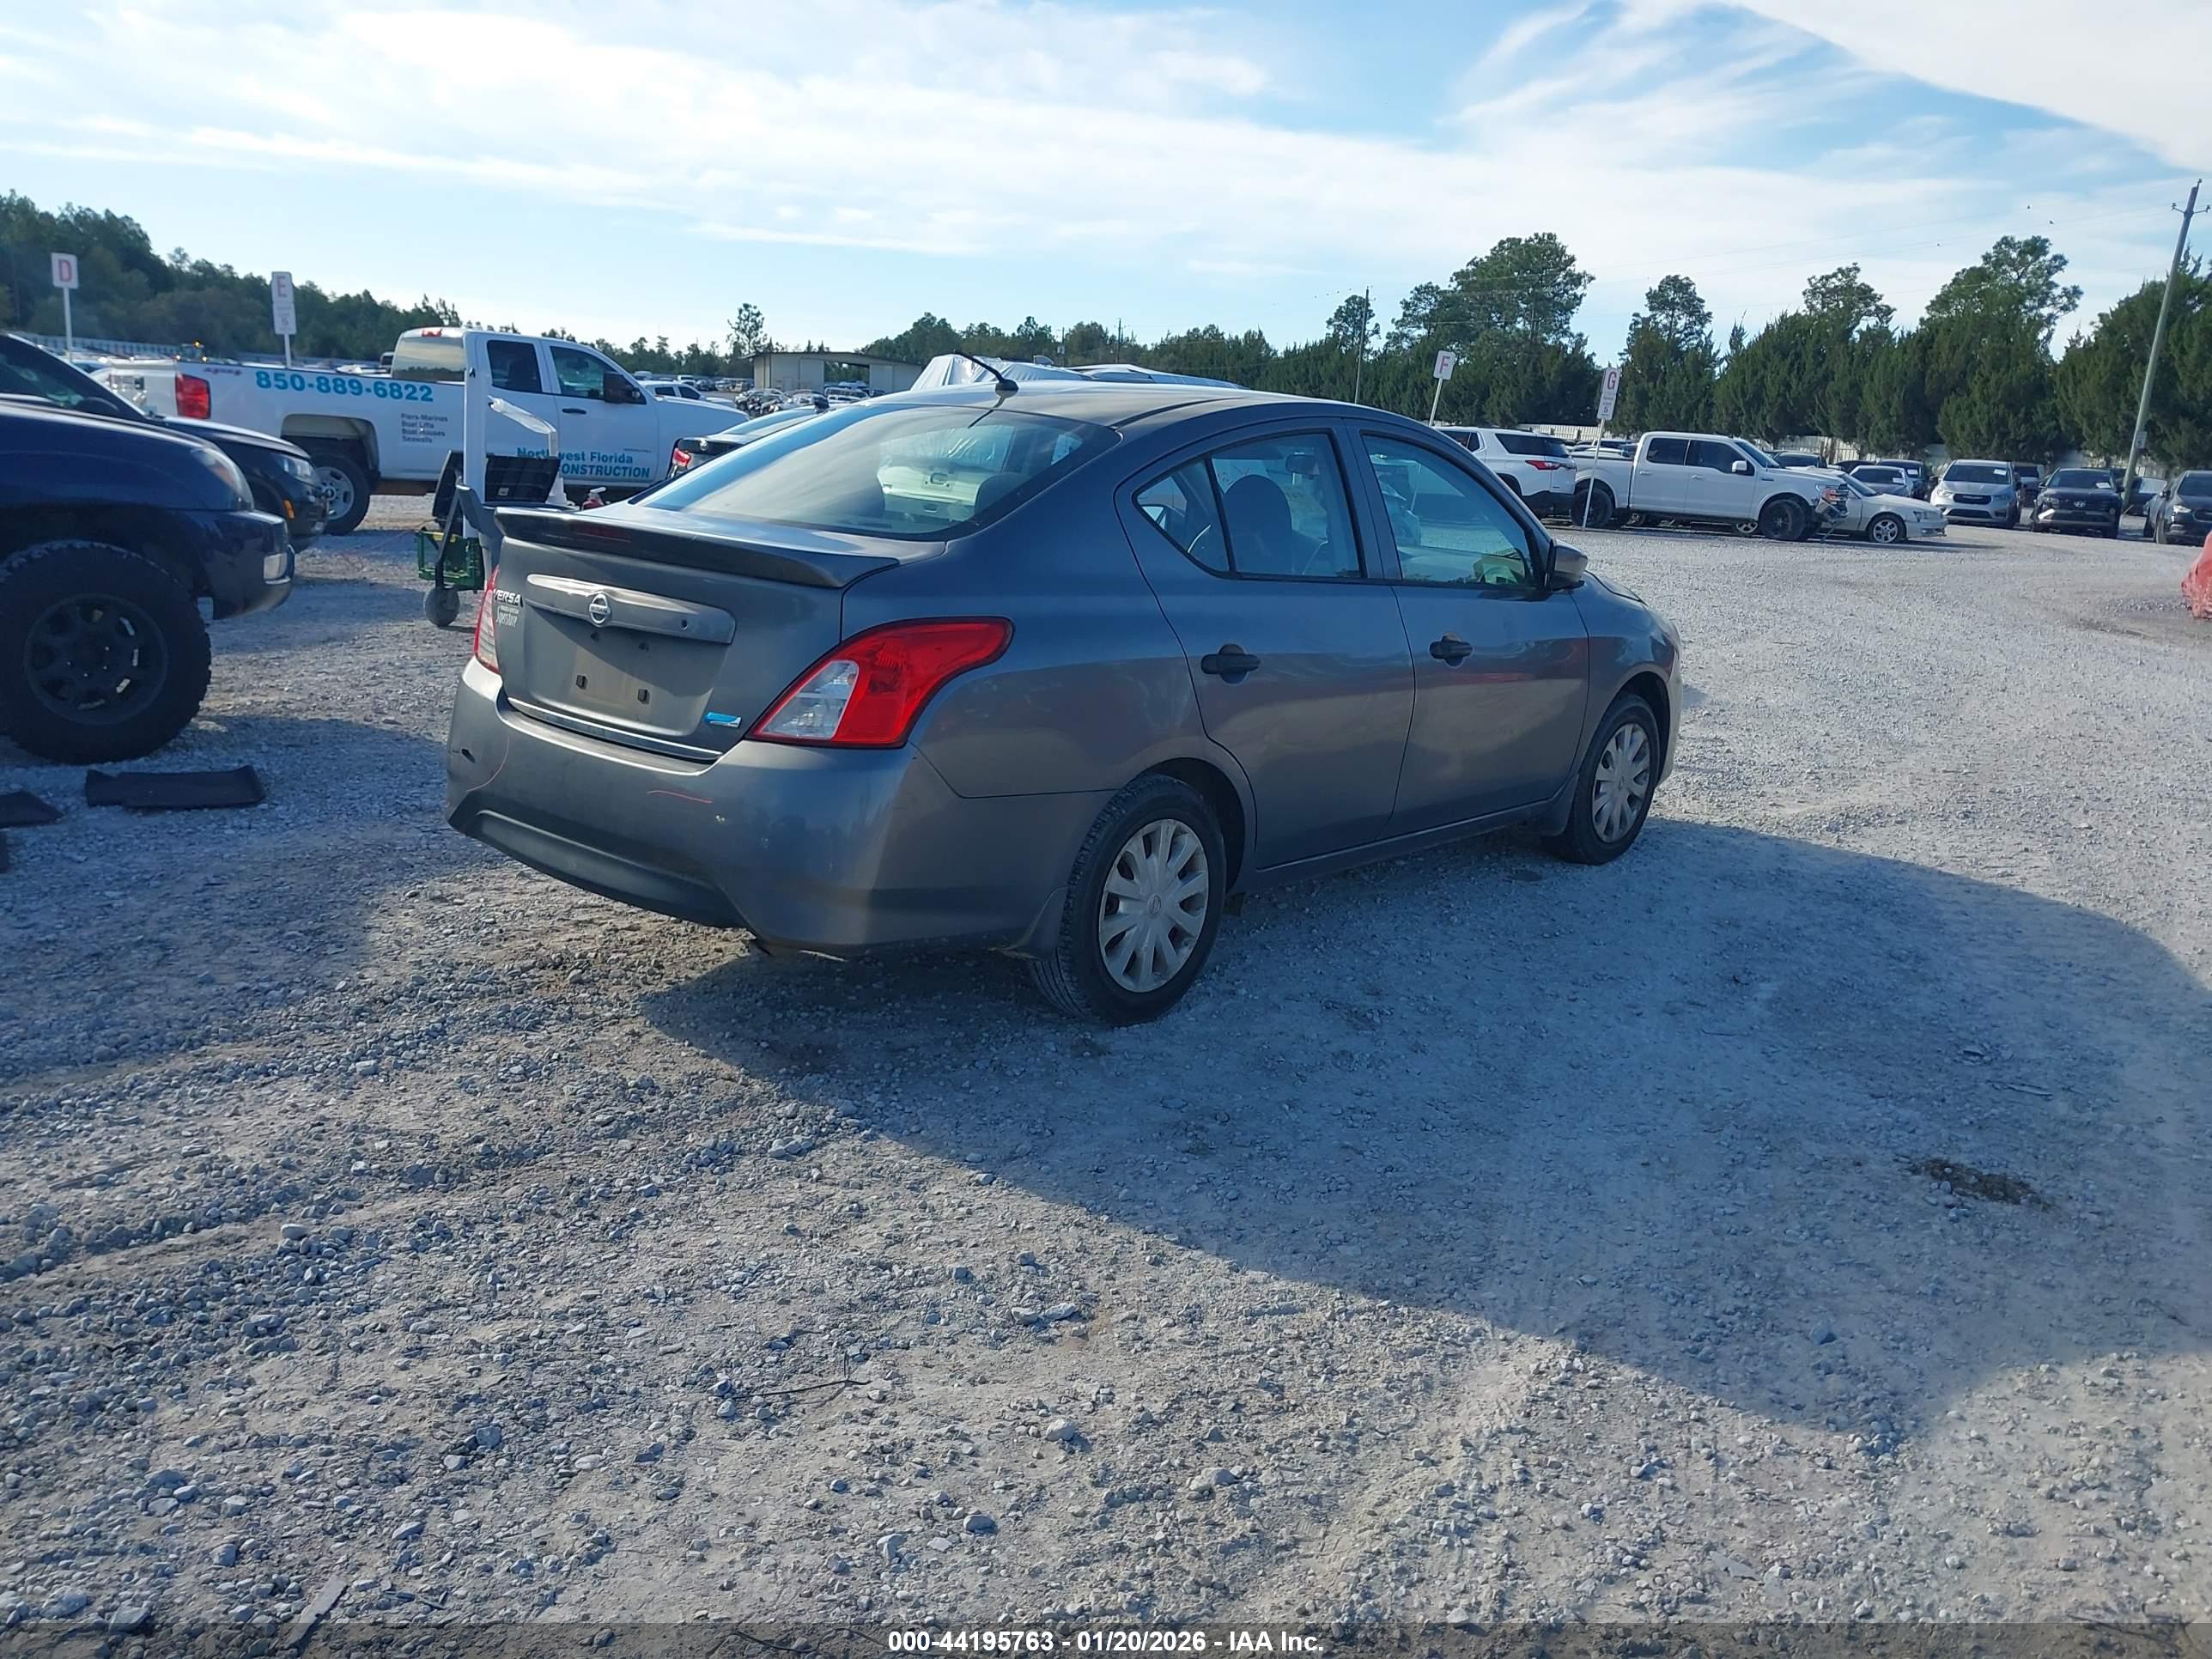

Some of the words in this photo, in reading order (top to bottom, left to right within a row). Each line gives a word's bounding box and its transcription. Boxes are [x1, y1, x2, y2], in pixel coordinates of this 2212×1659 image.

[58, 259, 73, 283] D
[276, 276, 288, 297] E
[1439, 355, 1451, 374] F
[256, 371, 434, 402] 850-889-6822
[1607, 371, 1617, 390] G
[590, 452, 634, 465] Florida
[559, 463, 650, 479] ONSTRUCTION
[493, 588, 523, 607] VERSA
